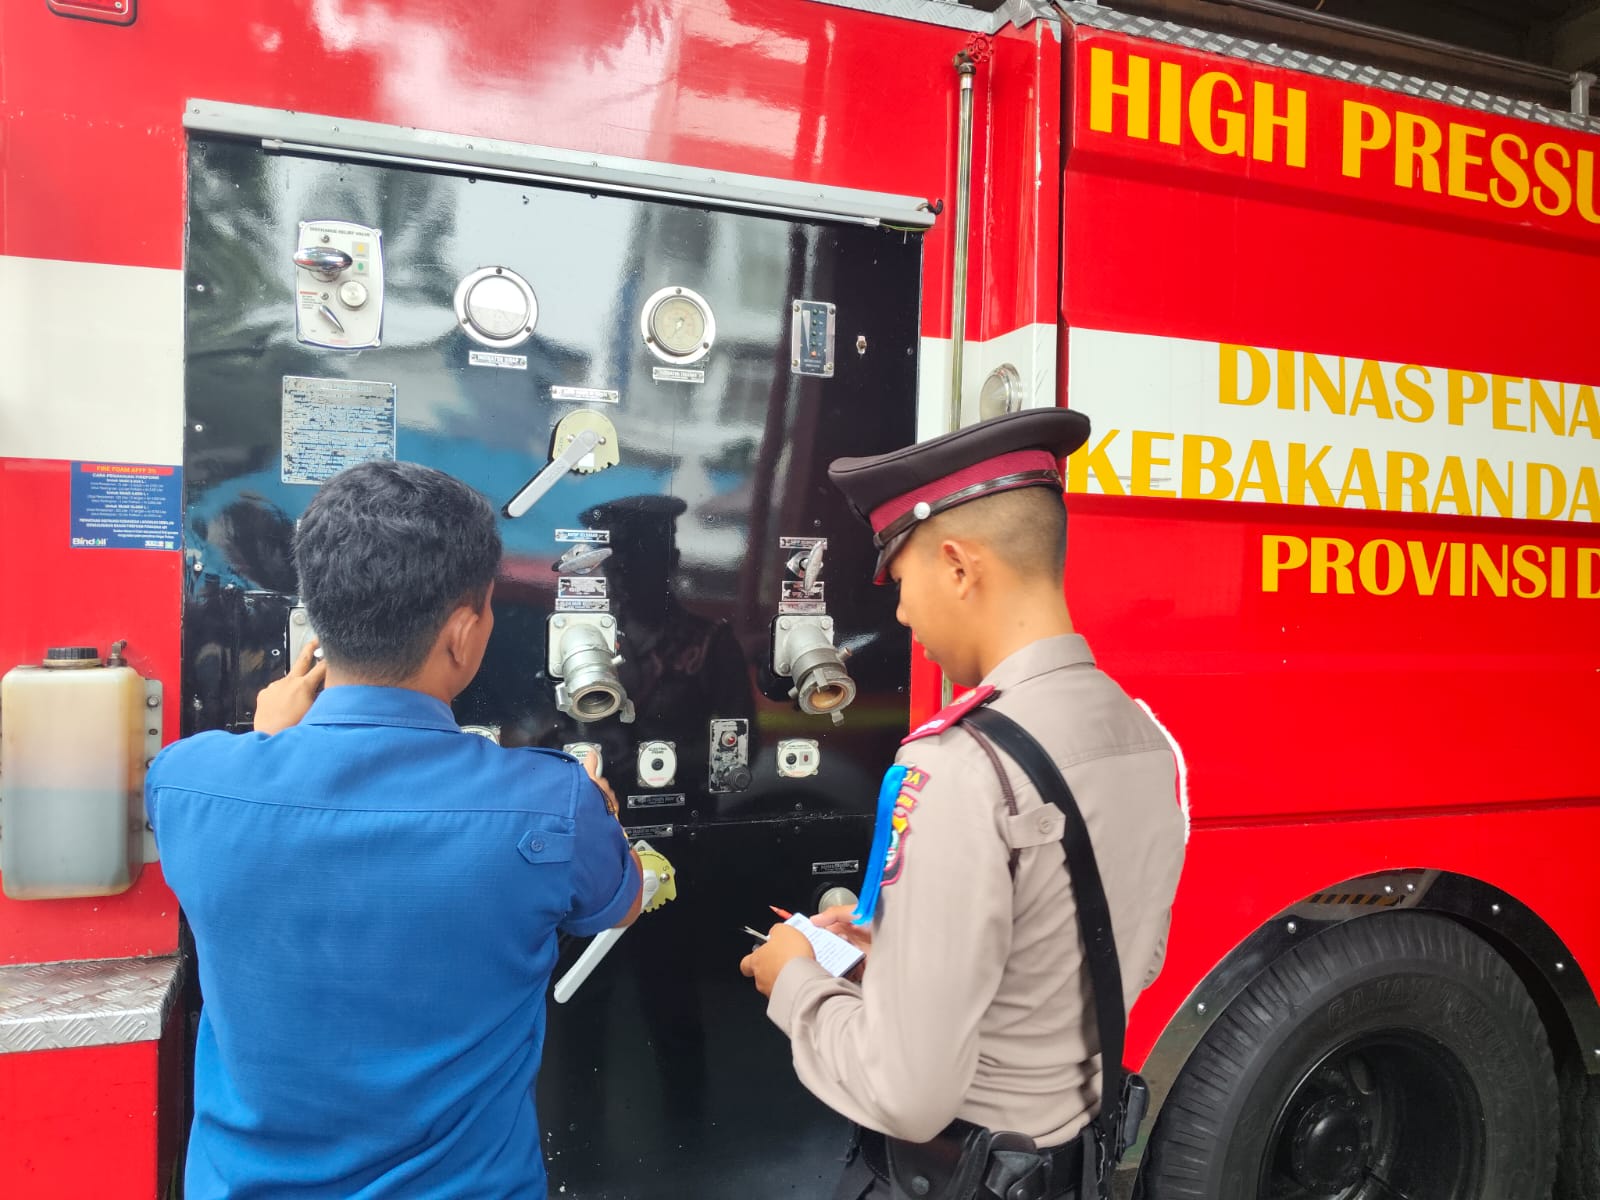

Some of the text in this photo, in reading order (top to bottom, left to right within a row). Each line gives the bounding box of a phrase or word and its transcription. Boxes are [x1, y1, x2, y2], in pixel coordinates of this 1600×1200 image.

[1090, 48, 1306, 167] HIGH
[1220, 343, 1600, 439] DINAS PENA
[1066, 430, 1600, 522] KEBAKARAN DA
[1262, 535, 1565, 598] PROVINSI
